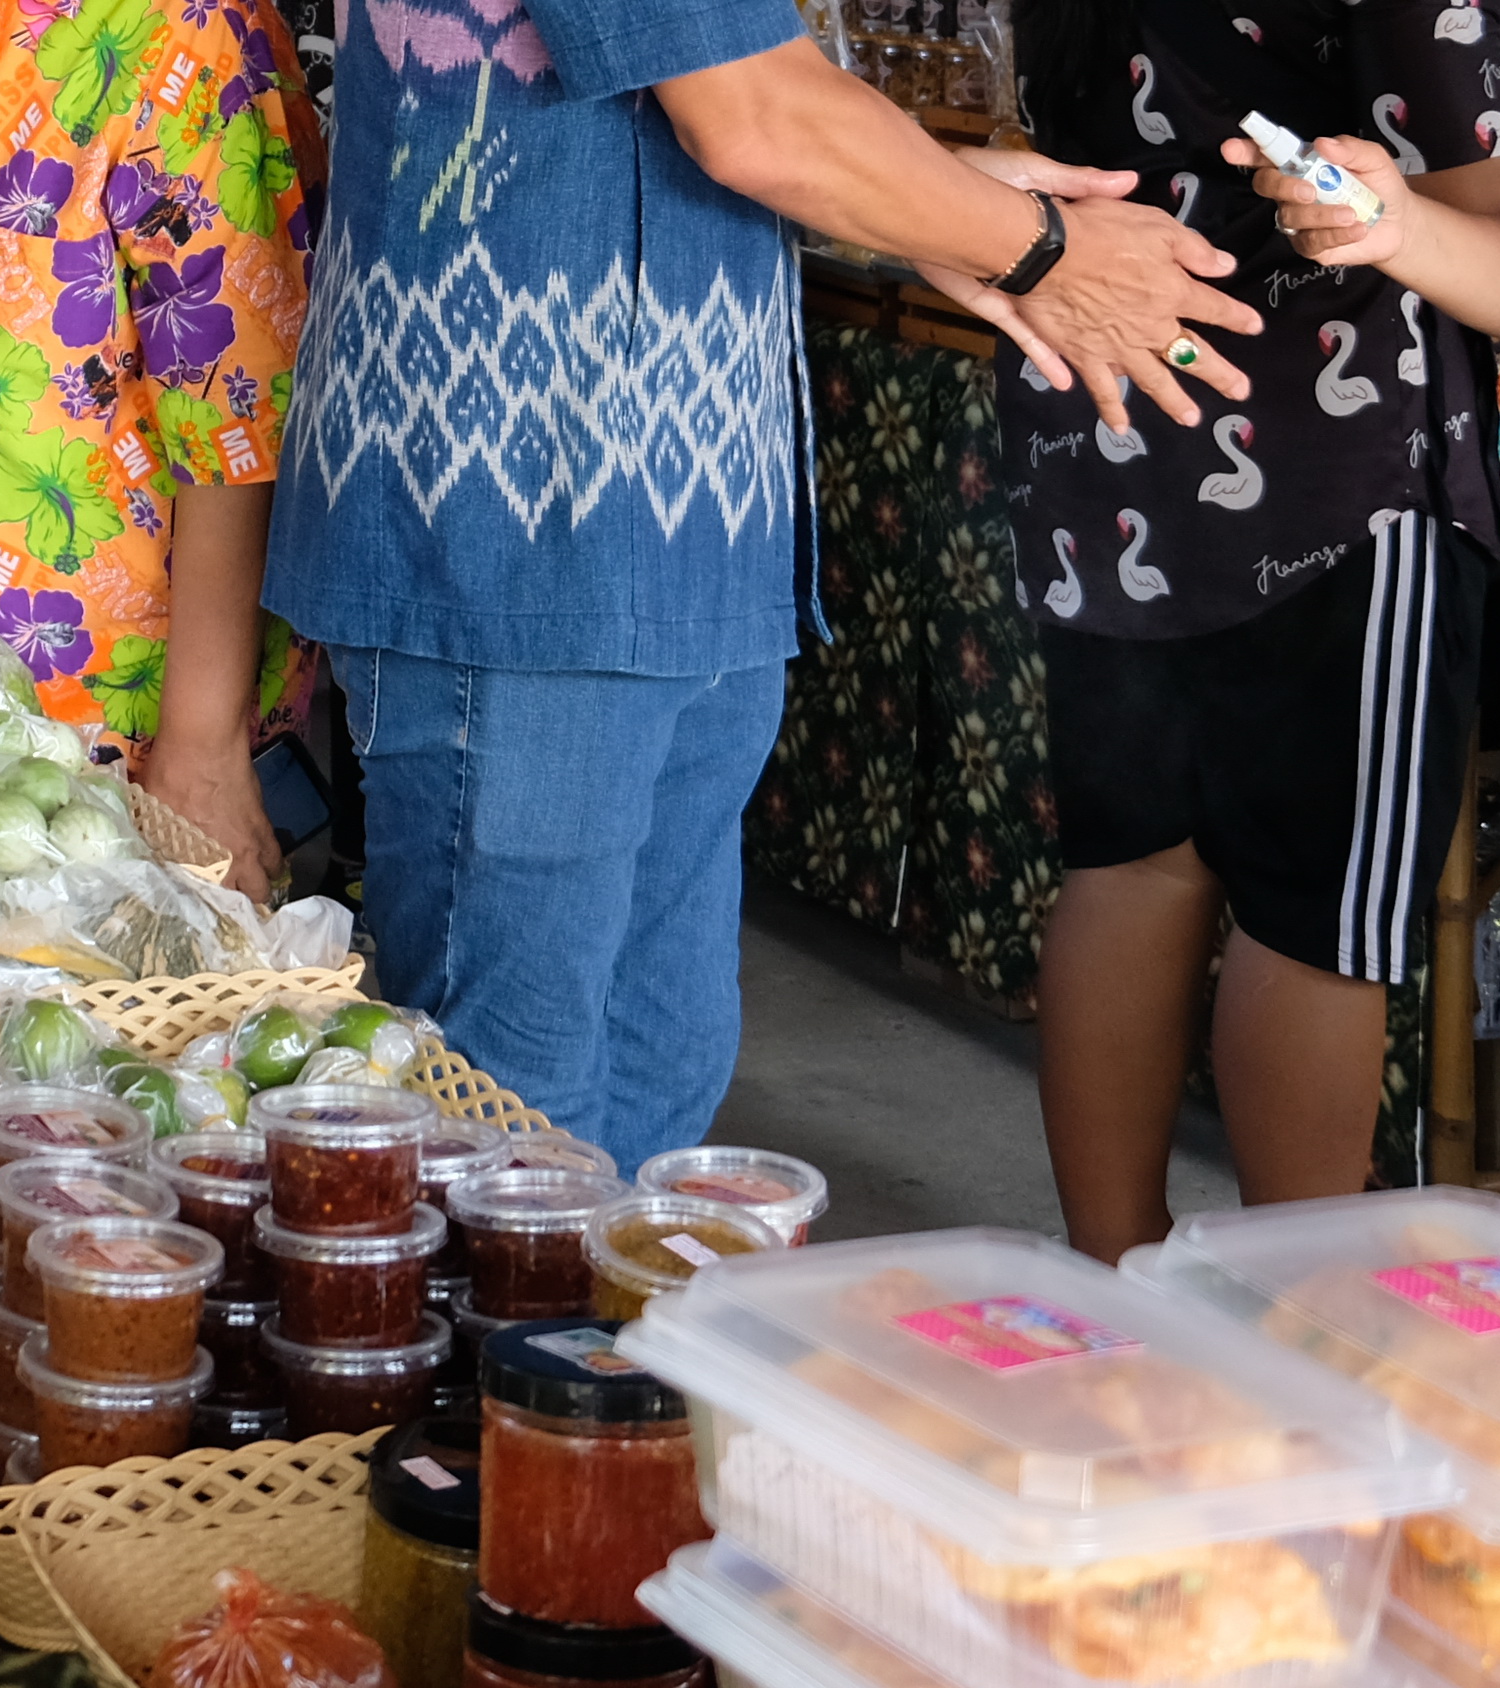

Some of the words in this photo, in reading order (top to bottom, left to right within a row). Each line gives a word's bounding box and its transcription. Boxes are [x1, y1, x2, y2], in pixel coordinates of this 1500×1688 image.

[158, 51, 196, 107] ME
[8, 101, 43, 152] ME
[1264, 263, 1347, 309] Flaming
[111, 430, 151, 481] ME
[217, 425, 260, 478] ME
